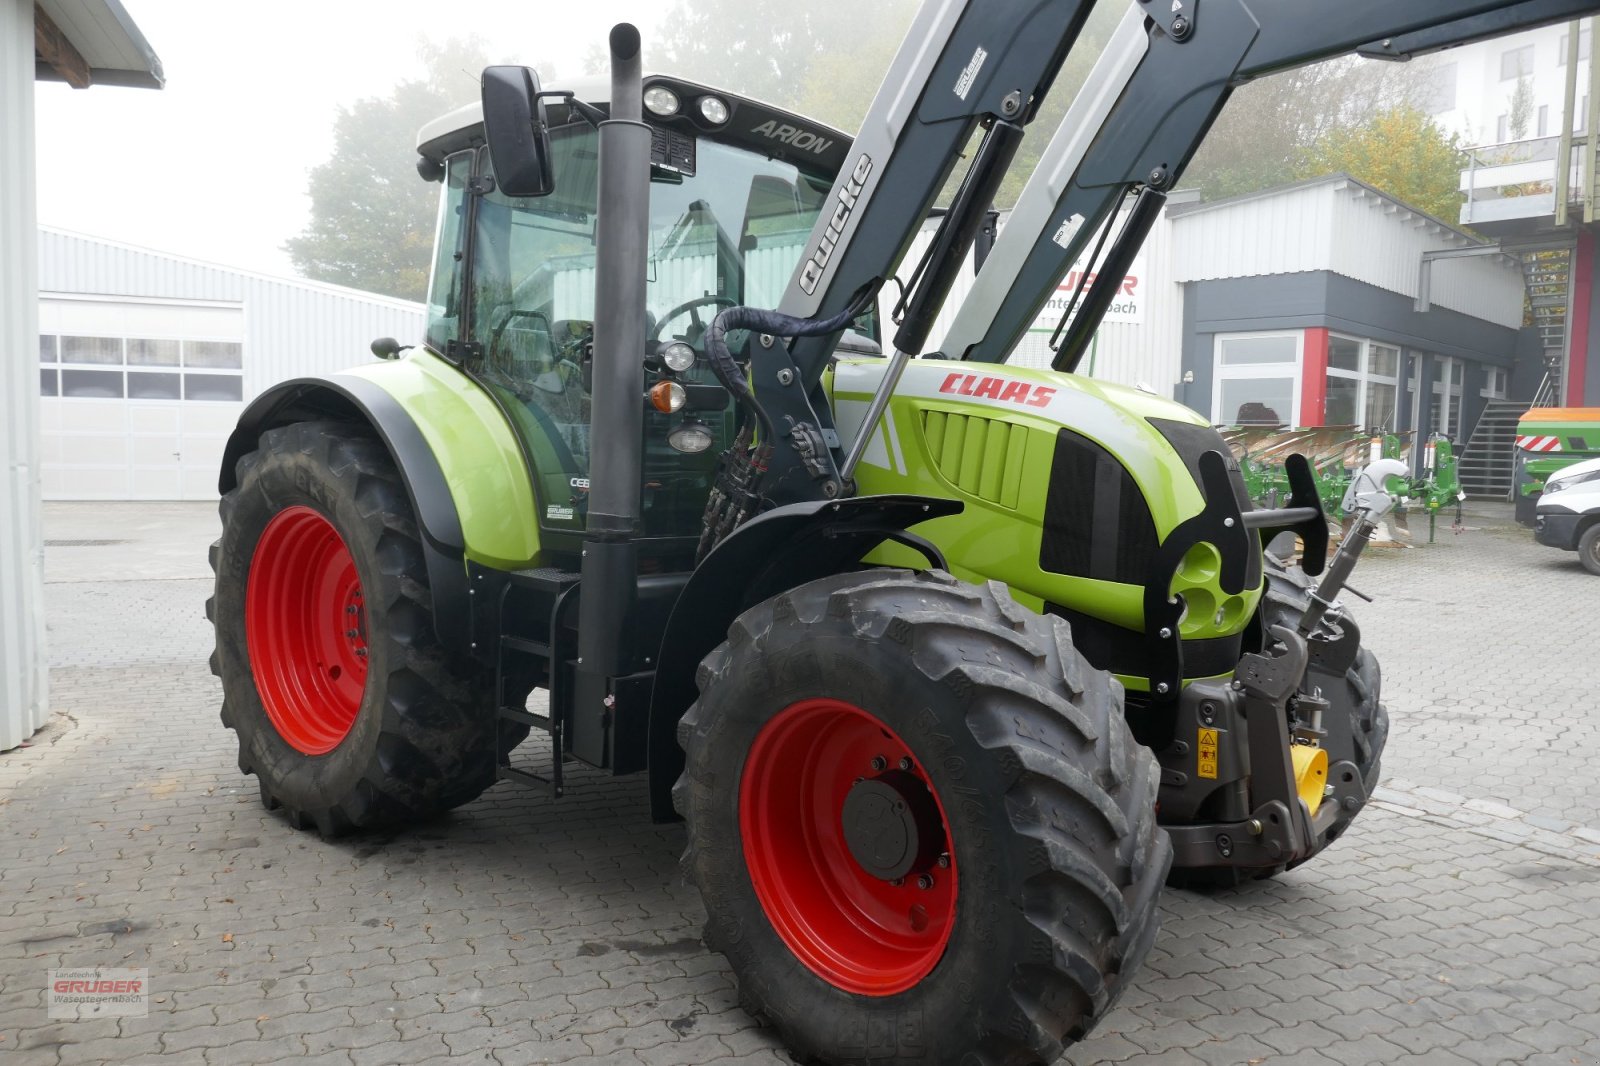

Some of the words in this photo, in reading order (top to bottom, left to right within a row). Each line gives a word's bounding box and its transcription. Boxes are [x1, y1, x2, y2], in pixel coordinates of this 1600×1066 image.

[955, 46, 985, 96] GRUBER
[750, 120, 833, 154] ARION
[799, 153, 873, 296] Quicke
[939, 372, 1057, 408] CLAAS
